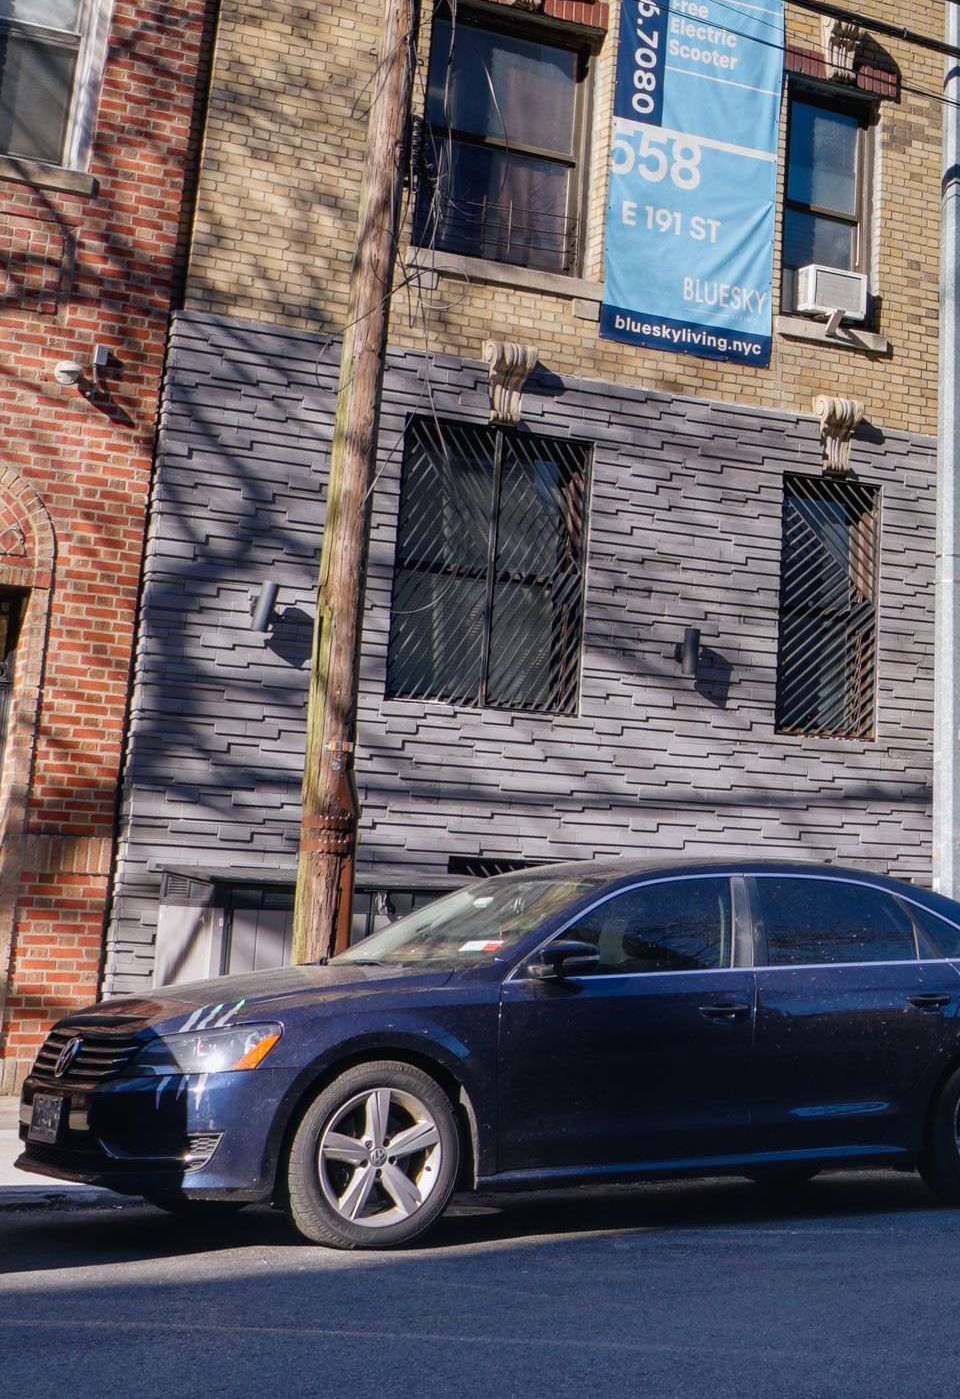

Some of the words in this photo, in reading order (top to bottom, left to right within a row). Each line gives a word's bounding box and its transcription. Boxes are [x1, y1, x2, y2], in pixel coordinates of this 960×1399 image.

[670, 18, 738, 48] Electric
[668, 39, 738, 70] Scooter
[611, 127, 702, 190] 558
[622, 200, 638, 227] E
[645, 205, 682, 236] 191
[689, 215, 722, 243] ST
[683, 277, 767, 315] BLUESKY
[614, 315, 762, 356] blueskyliving.nyc
